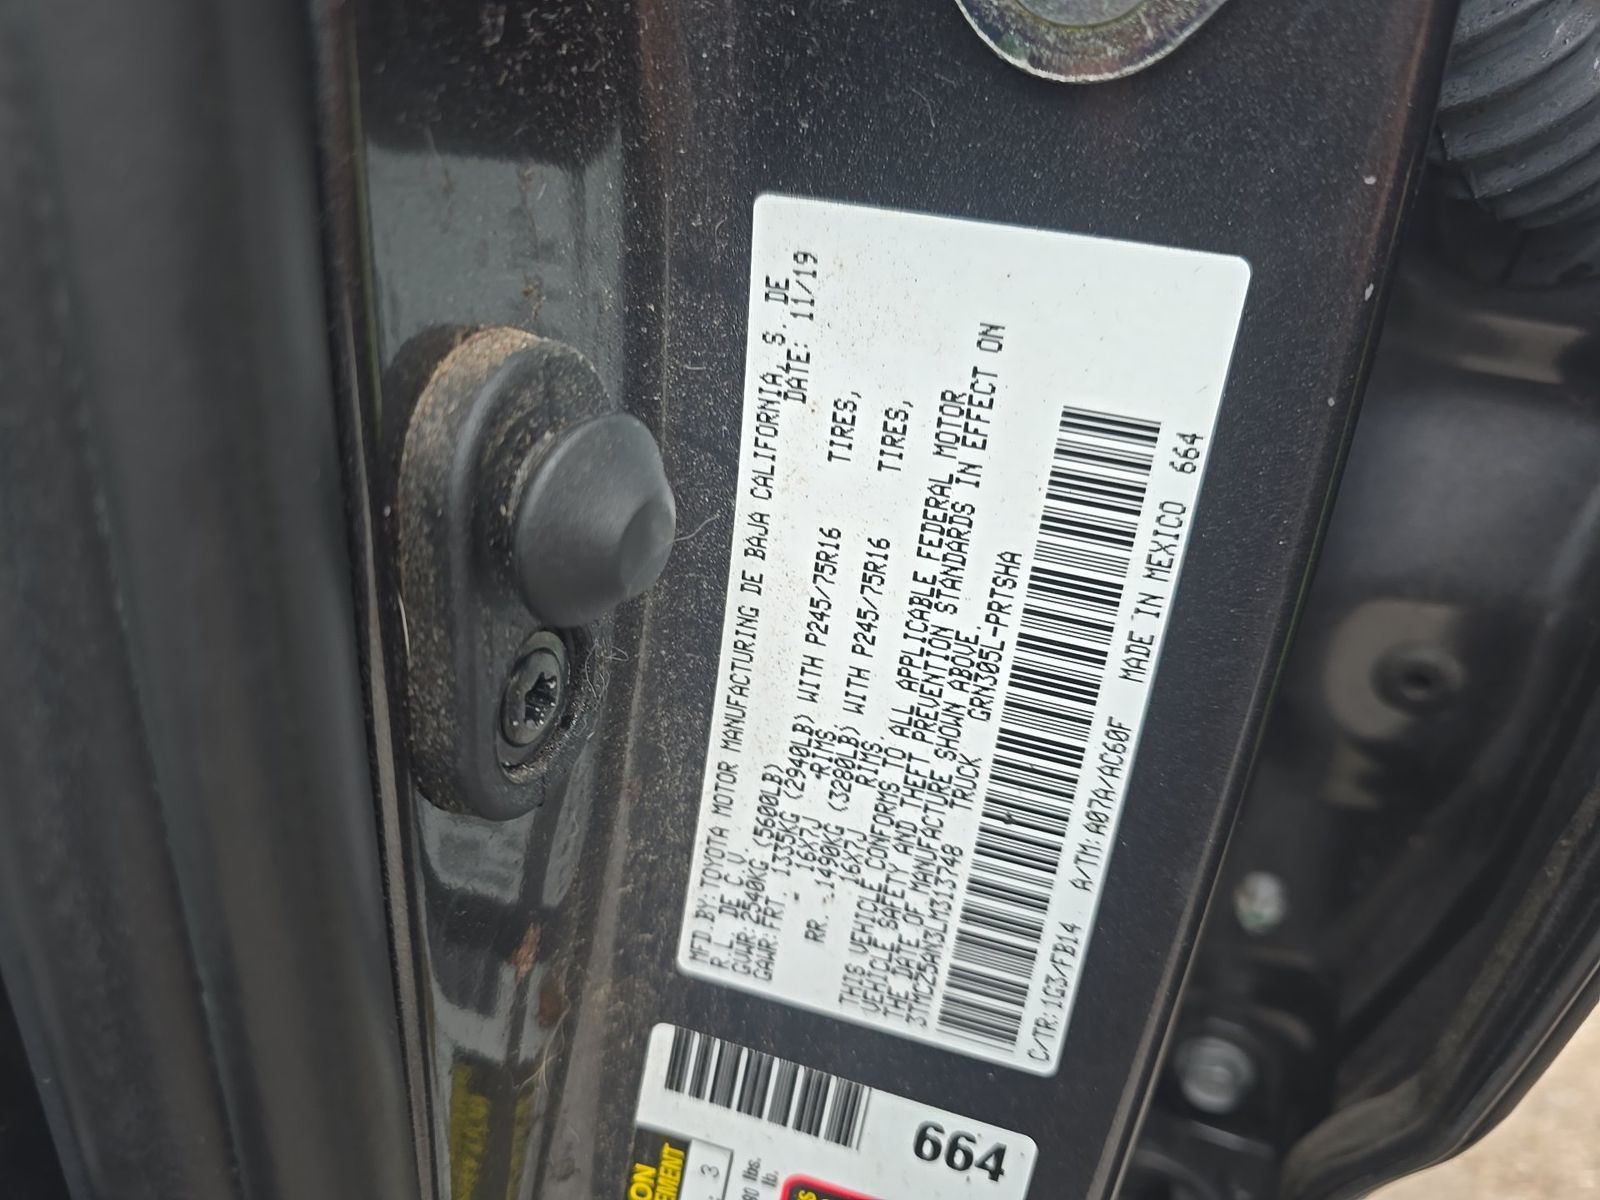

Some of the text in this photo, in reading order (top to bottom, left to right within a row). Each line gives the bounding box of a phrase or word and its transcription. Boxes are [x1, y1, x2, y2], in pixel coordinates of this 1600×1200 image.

[763, 273, 790, 305] DE
[782, 248, 818, 404] DATE: 11/19
[761, 319, 787, 346] S.
[749, 361, 786, 501] CALIFORNIA,
[827, 387, 862, 465] TIRES,
[1166, 428, 1205, 476] 664
[742, 509, 770, 561] BAJA
[1141, 497, 1188, 583] MEXICO
[739, 568, 763, 595] DE
[804, 524, 842, 646] P245/75R16
[1132, 590, 1165, 619] IN
[719, 603, 759, 753] MANUFACTURING
[796, 653, 824, 704] WITH
[804, 396, 914, 944] RR. 1490KG (3280LB) WITH P245/75R16 TIRES,
[860, 321, 1006, 1015] VEHICLE SAFETY AND THEFT PREVENTION STANDARDS IN EFFECT ON
[1117, 628, 1155, 683] MADE
[837, 387, 968, 1008] THIS VEHICLE CONFORMS TO ALL APPLICABLE FEDERAL MOTOR
[711, 758, 739, 818] MOTOR
[782, 711, 816, 801] (2940LB)
[794, 719, 839, 873] 16X7J RIMS.
[905, 548, 1023, 1028] 3TMCZ5AN3LM313748 TRUCK GRN305L-PRTSHA
[751, 761, 785, 849] (5600LB)
[770, 809, 800, 877] 1335KG
[838, 730, 885, 885] 16X7J RIMS.
[882, 620, 982, 1021] THE DATE OF MANUFACTURE SHOWN ABOVE.
[709, 842, 749, 971] R.L. DE C.V.
[700, 1163, 720, 1179] 3
[741, 1157, 762, 1182] lbs.
[760, 1170, 779, 1188] lb.
[913, 1120, 1009, 1183] 664
